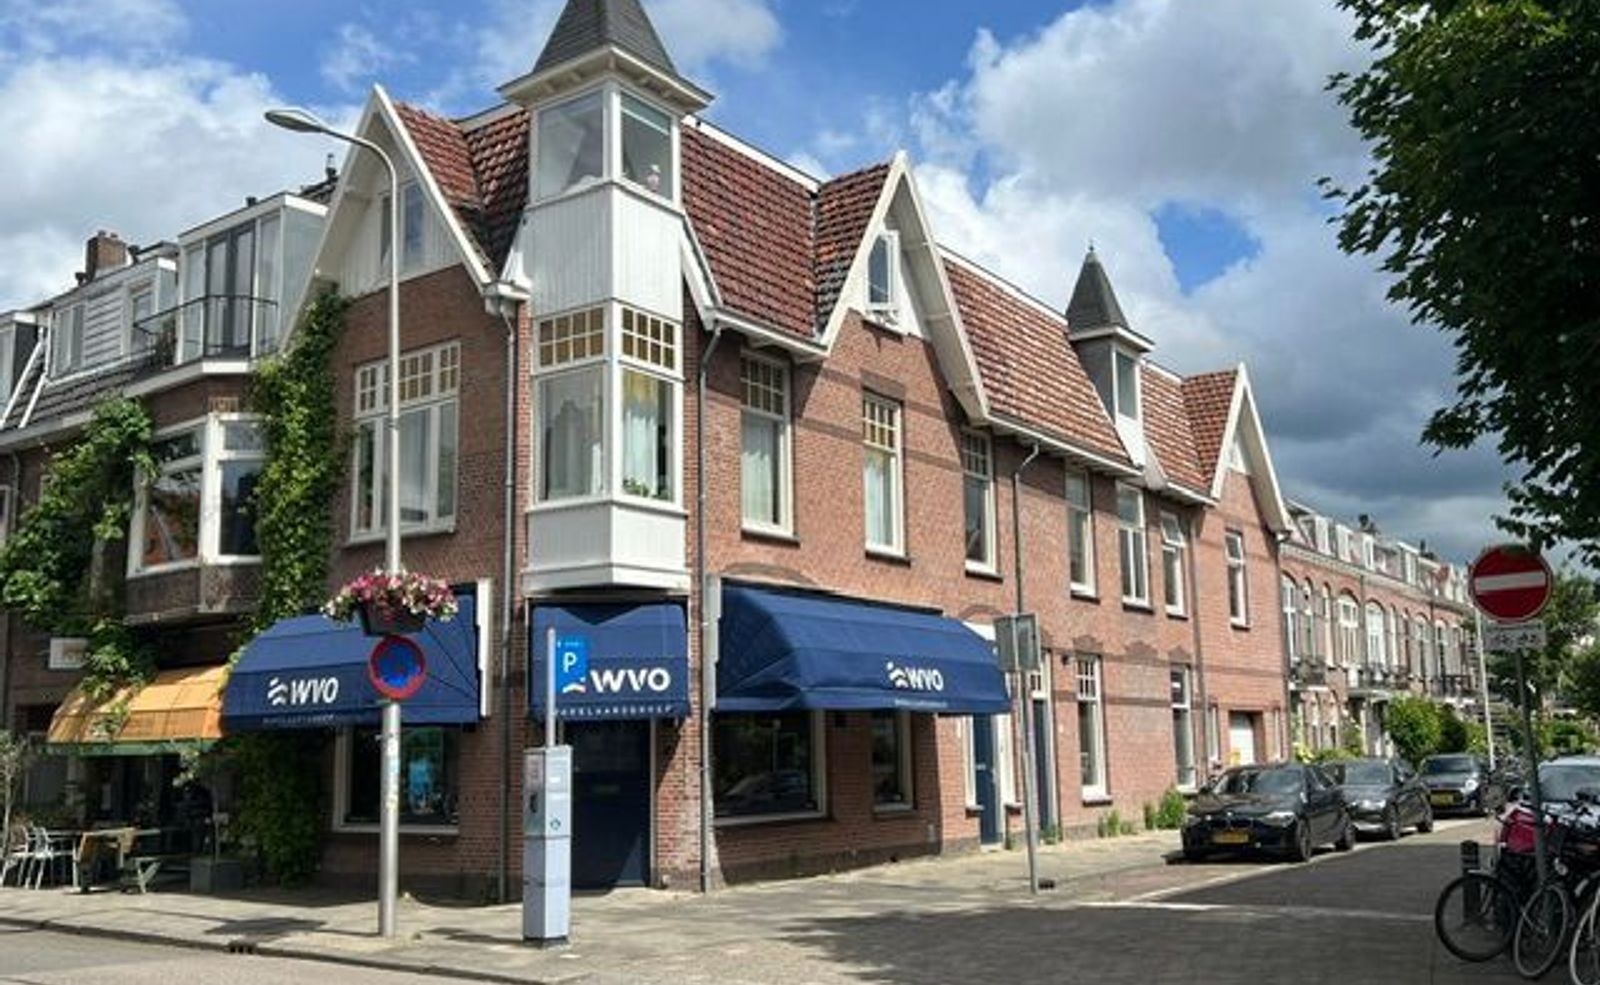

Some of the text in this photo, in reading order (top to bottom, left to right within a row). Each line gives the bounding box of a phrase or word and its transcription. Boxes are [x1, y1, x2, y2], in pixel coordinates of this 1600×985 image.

[562, 652, 577, 673] P
[590, 667, 671, 693] WVO
[905, 667, 944, 691] WVO
[290, 677, 339, 706] WVO
[552, 705, 674, 717] AKELAARSGROEP
